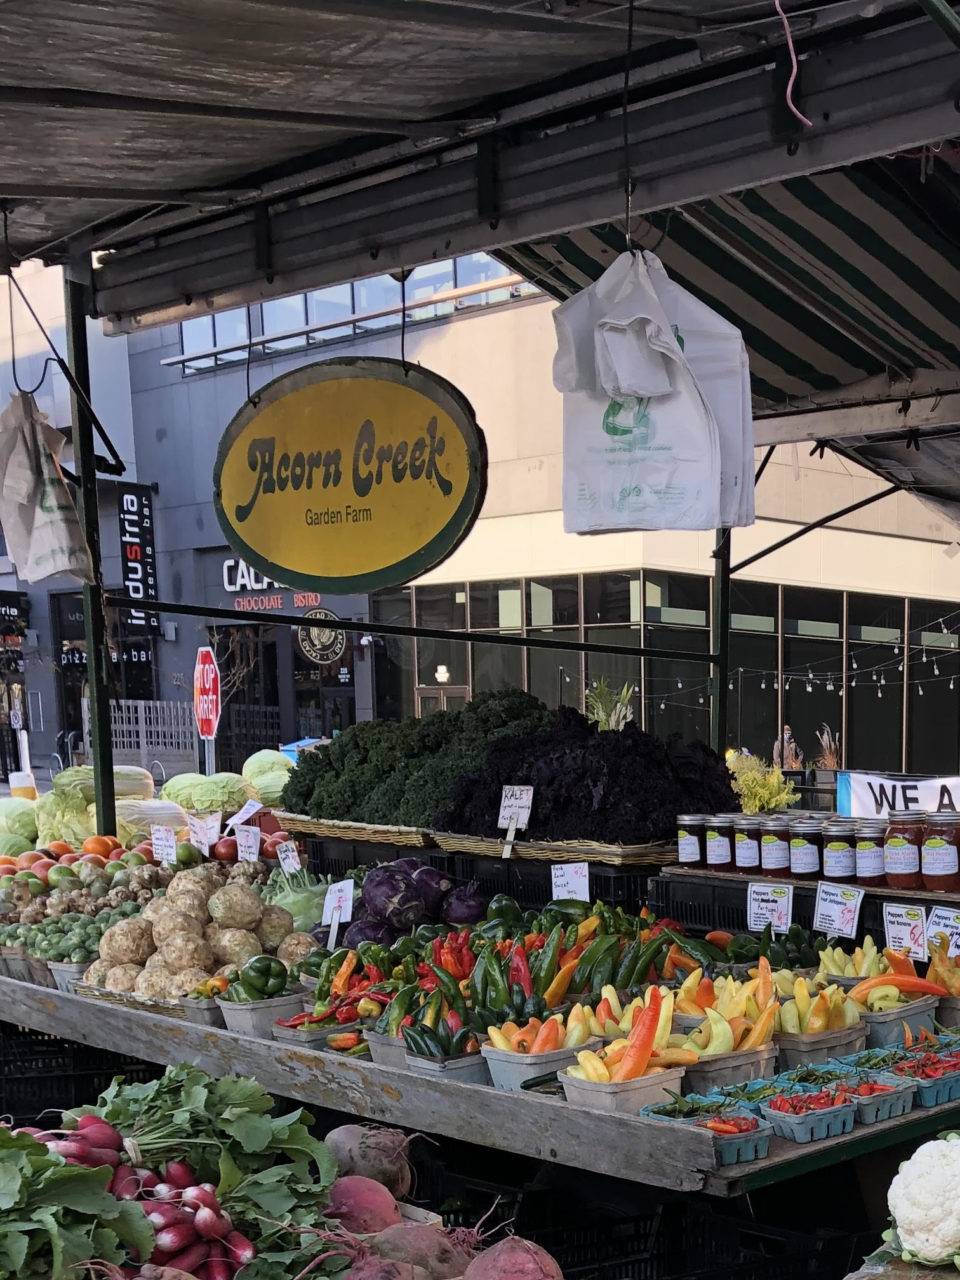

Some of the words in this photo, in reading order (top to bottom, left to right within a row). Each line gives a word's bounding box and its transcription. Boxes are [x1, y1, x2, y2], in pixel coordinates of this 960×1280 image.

[235, 436, 343, 523] Acorn
[352, 415, 454, 498] Creek
[142, 496, 151, 527] bar
[305, 507, 343, 526] Garden
[345, 505, 372, 524] Farm
[145, 546, 159, 626] pzeria
[223, 558, 289, 592] CACA
[234, 595, 283, 611] CHOCOLATE
[293, 592, 321, 608] BISTRO
[196, 664, 215, 688] TOP
[866, 781, 920, 815] WE
[821, 888, 839, 898] Peppers
[887, 911, 904, 919] Peppers
[934, 913, 951, 922] Peppers
